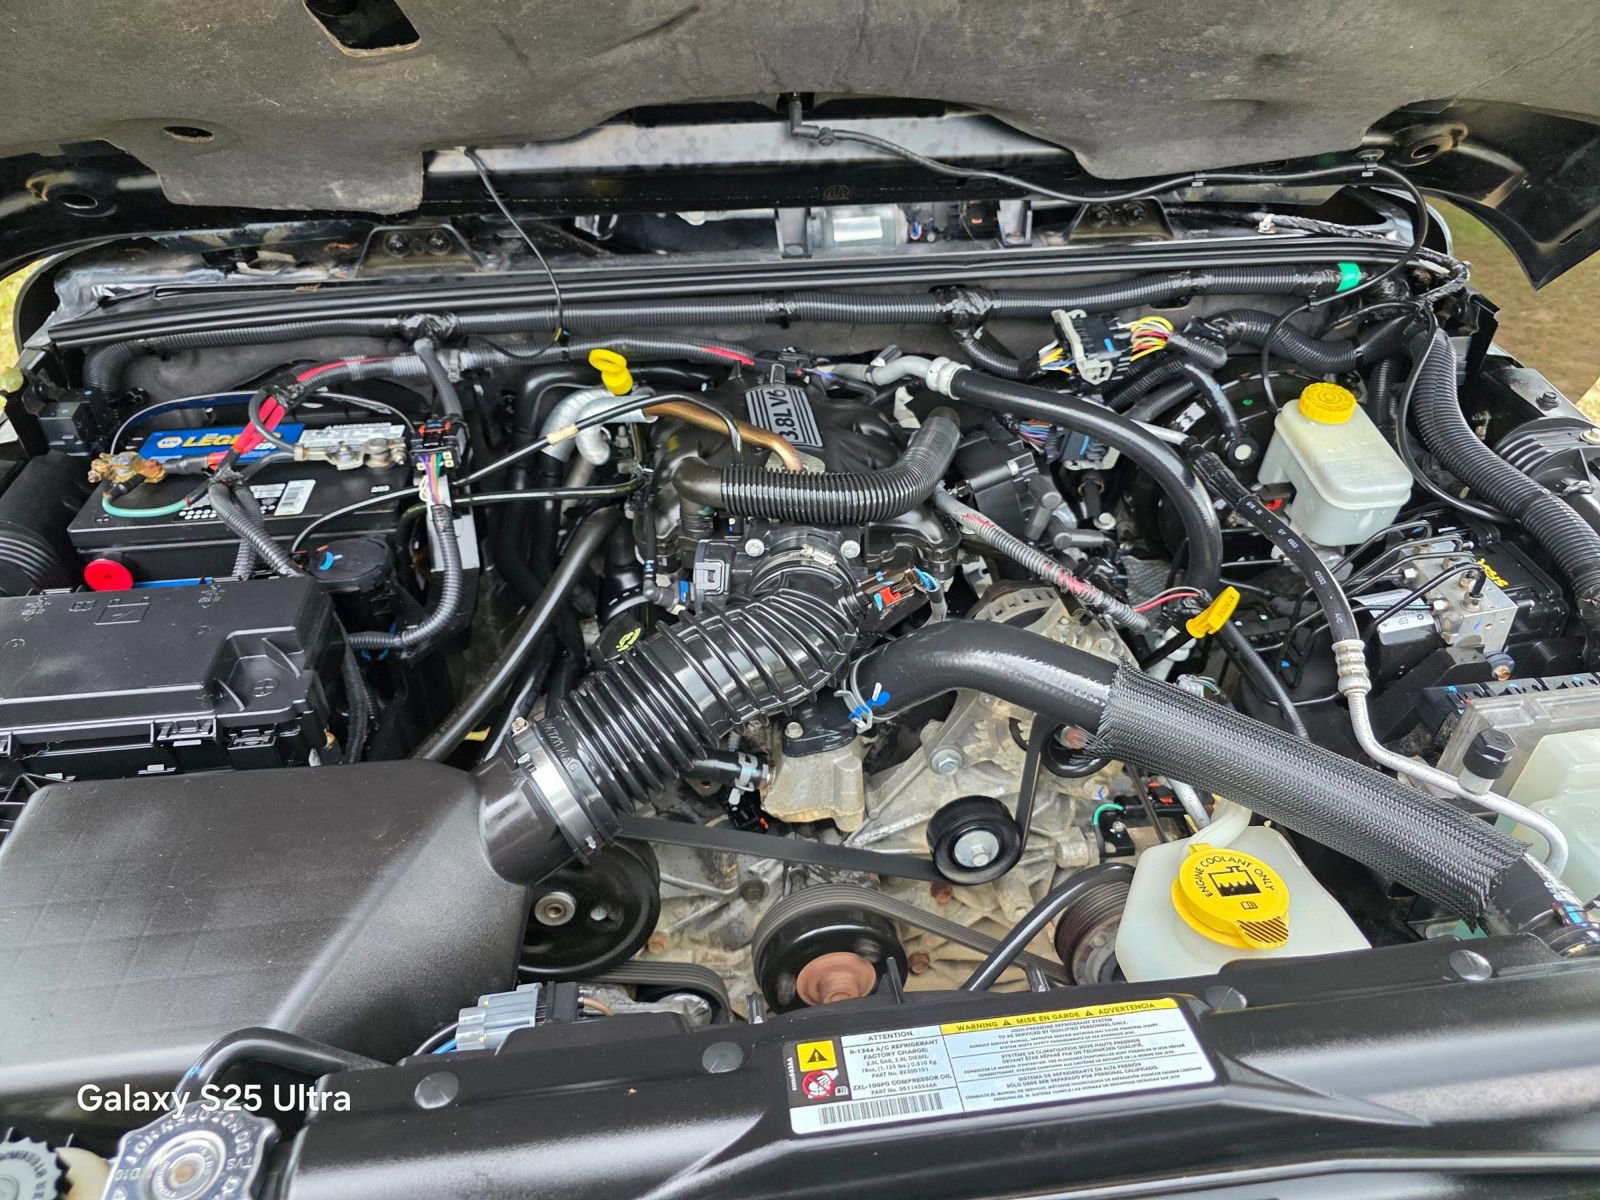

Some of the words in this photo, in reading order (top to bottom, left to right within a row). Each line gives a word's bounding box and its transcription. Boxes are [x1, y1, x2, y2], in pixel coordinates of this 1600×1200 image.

[767, 389, 788, 407] V6
[773, 408, 799, 441] 3.8L
[1200, 855, 1253, 868] COOLANT
[1194, 867, 1213, 897] ENGINE
[1254, 868, 1275, 891] ONLY
[956, 1022, 998, 1031] WARNING
[1051, 1012, 1080, 1020] GARDE
[1098, 1003, 1156, 1014] ADVERTENCIA
[867, 1031, 913, 1041] ATTENTION
[891, 1039, 939, 1049] REFRIGERANT
[863, 1052, 896, 1060] FACTORY
[897, 1048, 929, 1056] CHARGE:
[891, 1075, 939, 1086] COMPRESSOR
